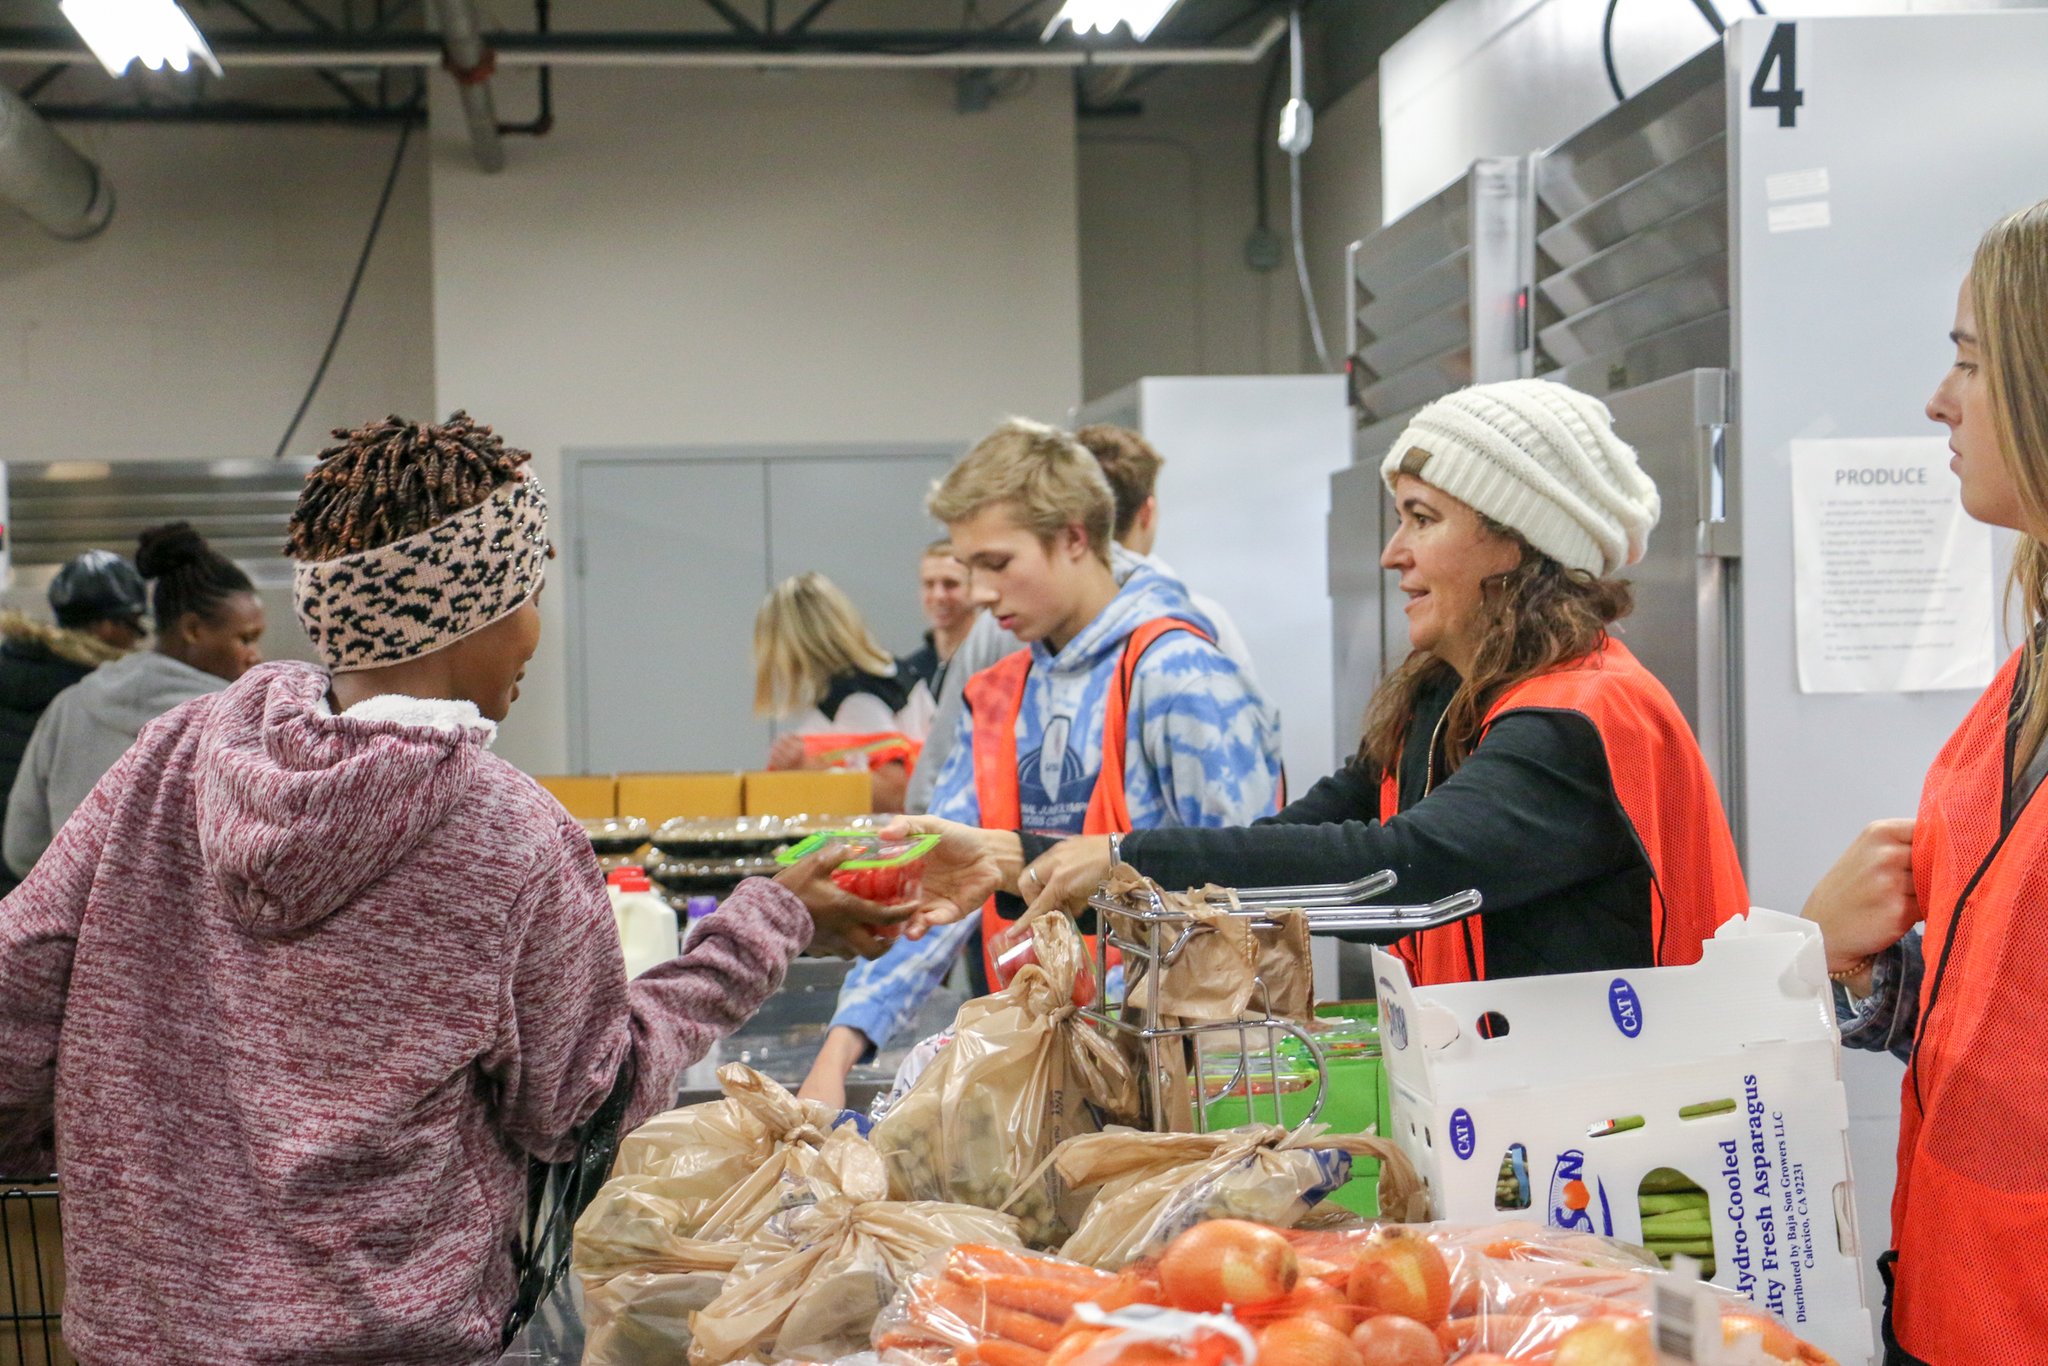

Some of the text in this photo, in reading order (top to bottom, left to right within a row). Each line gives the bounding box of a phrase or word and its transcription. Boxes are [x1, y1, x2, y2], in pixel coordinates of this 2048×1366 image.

[1750, 21, 1804, 128] 4
[1834, 467, 1927, 486] PRODUCE
[1616, 998, 1637, 1031] CAT
[1456, 1125, 1470, 1154] CAT
[1744, 1074, 1772, 1198] Asparagus
[1719, 1139, 1757, 1301] Hydro-Cooled
[1755, 1205, 1779, 1272] Fresh
[1772, 1111, 1807, 1323] Distributed by Baja Son Growers LLC
[1793, 1163, 1814, 1269] Calexico, CA 92231
